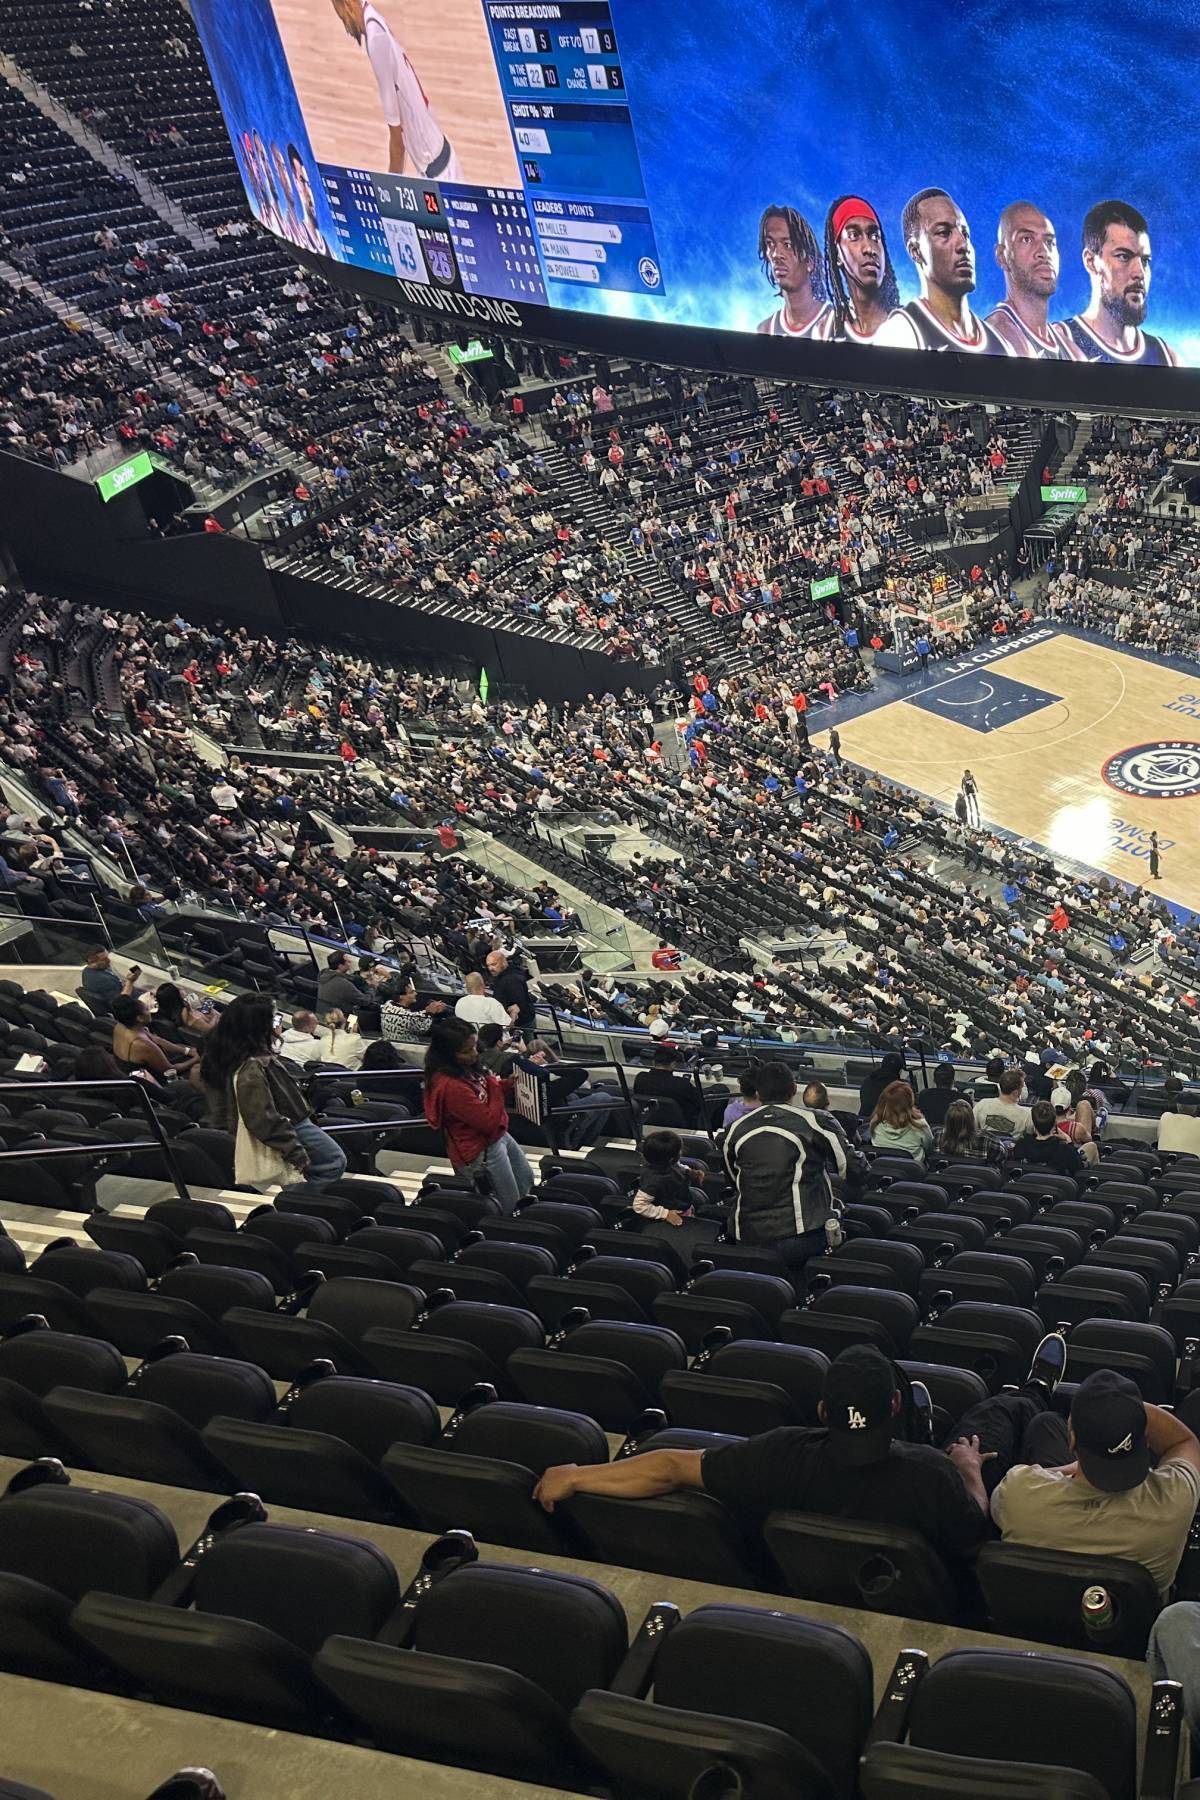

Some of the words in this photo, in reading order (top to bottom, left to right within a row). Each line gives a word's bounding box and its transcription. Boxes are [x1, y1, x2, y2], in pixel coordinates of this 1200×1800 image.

[490, 6, 515, 18] POINTS
[515, 5, 560, 18] BREAKDOWN
[396, 187, 418, 211] 7:31
[534, 201, 563, 214] LEADERS
[568, 204, 594, 216] POINTS
[546, 224, 567, 234] MILLER
[550, 244, 569, 255] MANN
[428, 250, 451, 278] 26
[112, 466, 135, 489] Sprite
[1049, 488, 1078, 500] Sprite
[814, 580, 836, 595] Sprite
[945, 662, 974, 674] LA
[973, 628, 1054, 662] CLIPPERS
[1161, 788, 1198, 797] LOS
[847, 1406, 866, 1429] LA
